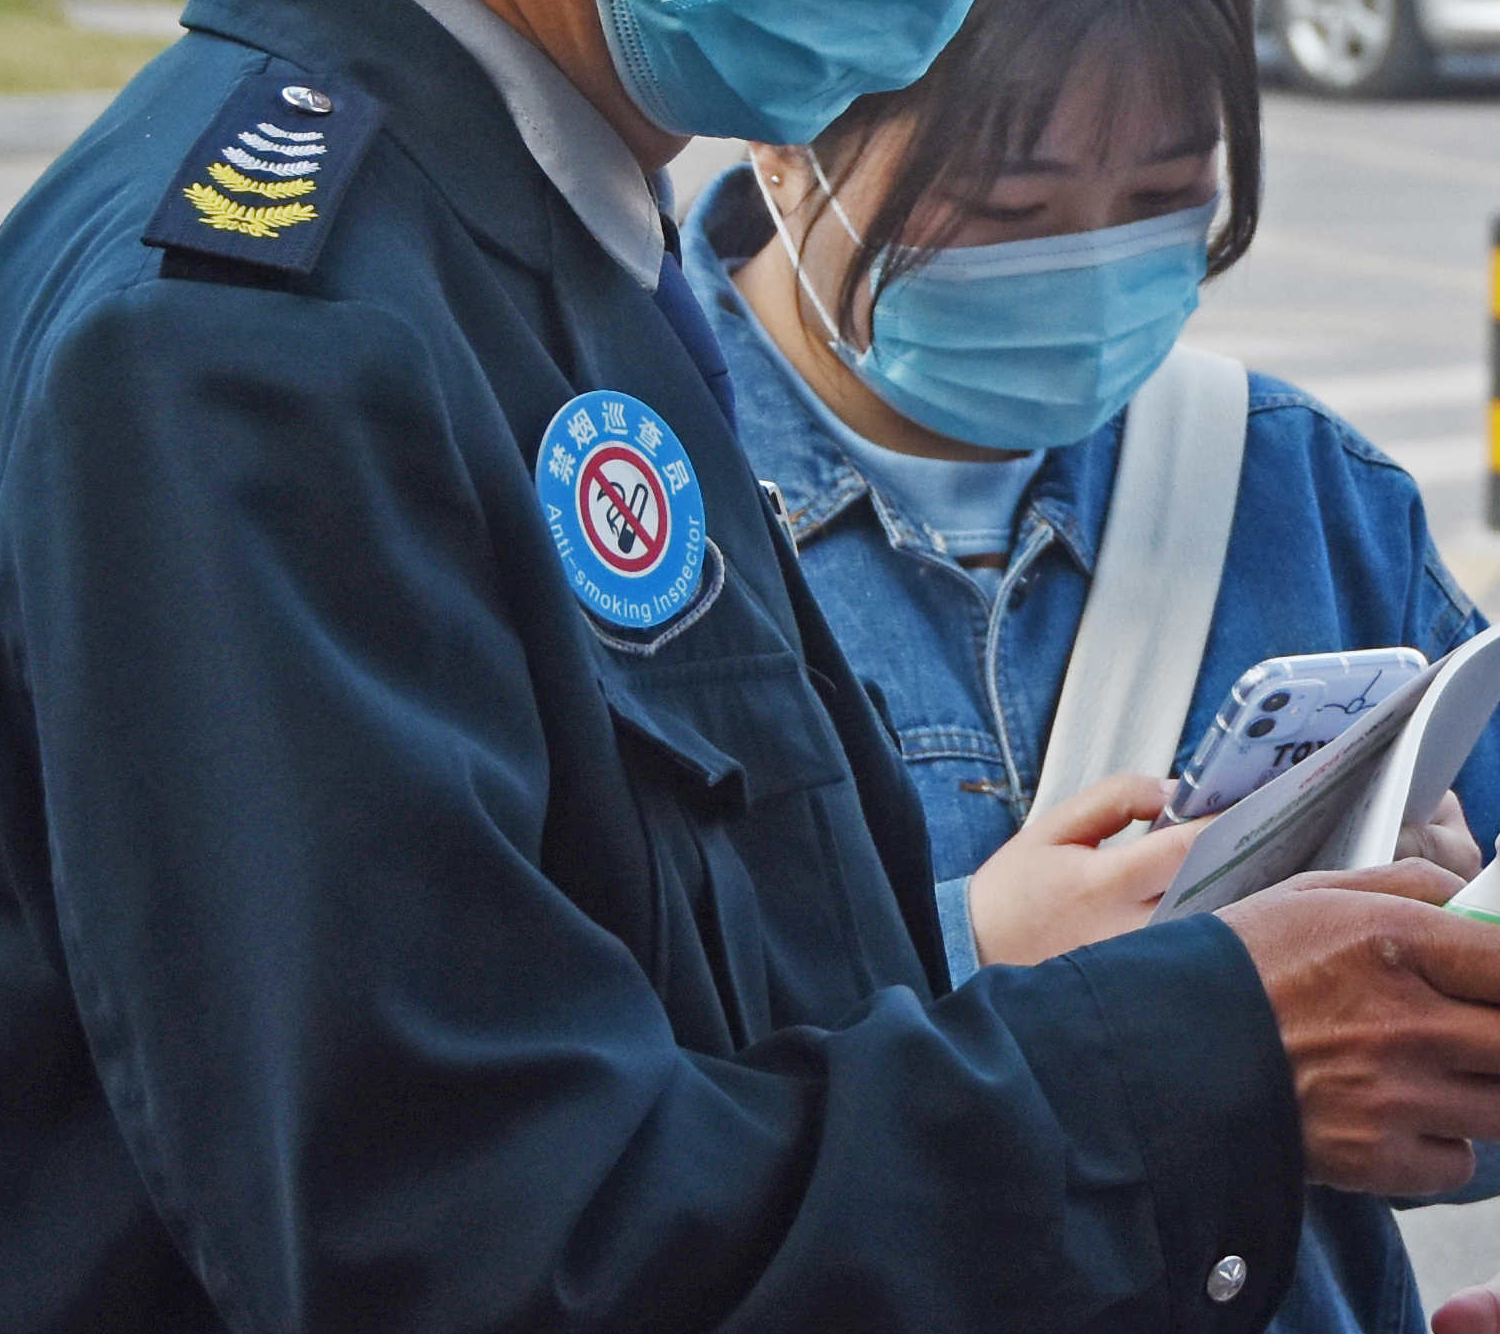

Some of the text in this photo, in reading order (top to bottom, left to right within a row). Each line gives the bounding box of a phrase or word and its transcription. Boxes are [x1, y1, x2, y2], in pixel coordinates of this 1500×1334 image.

[548, 401, 690, 495] 禁烟巡查员
[547, 503, 701, 623] Anti-smoking Inspector
[1272, 739, 1331, 767] TO
